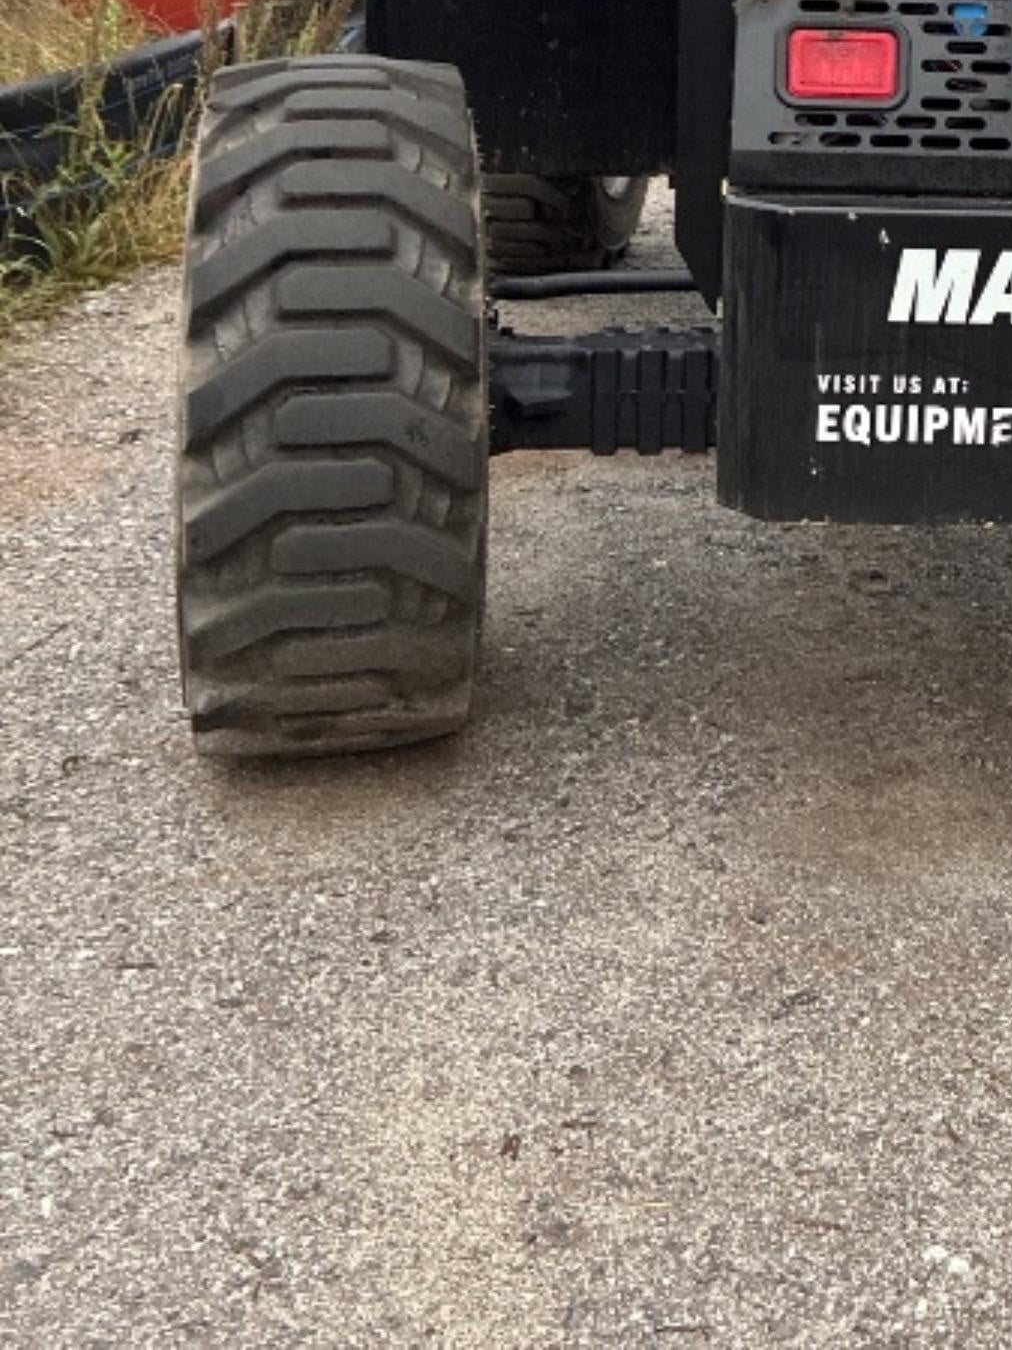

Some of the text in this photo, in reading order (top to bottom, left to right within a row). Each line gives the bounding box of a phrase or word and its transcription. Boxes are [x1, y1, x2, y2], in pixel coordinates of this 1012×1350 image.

[817, 374, 970, 394] VISIT US AT:
